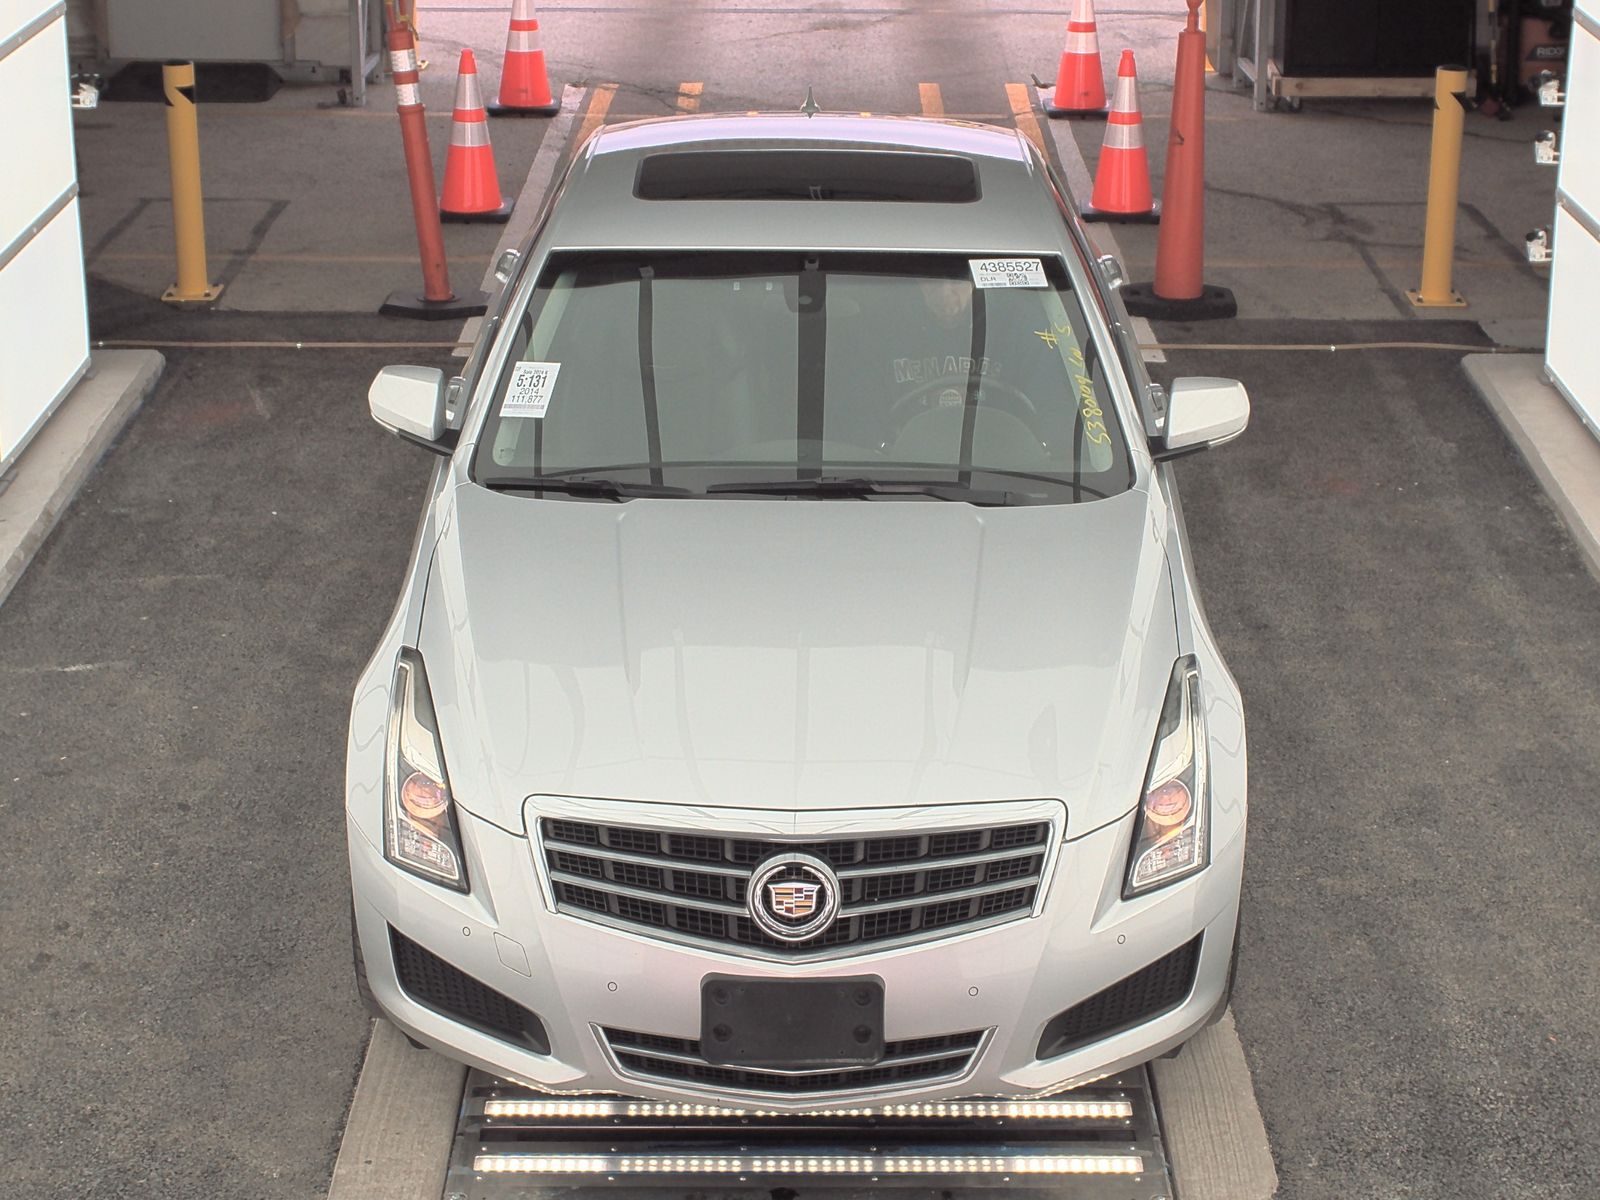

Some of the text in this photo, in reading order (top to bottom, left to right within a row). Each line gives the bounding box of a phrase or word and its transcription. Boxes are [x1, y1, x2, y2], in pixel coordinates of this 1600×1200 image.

[980, 261, 1040, 272] 4385527
[517, 375, 547, 388] 5:131
[512, 395, 544, 404] 111,877
